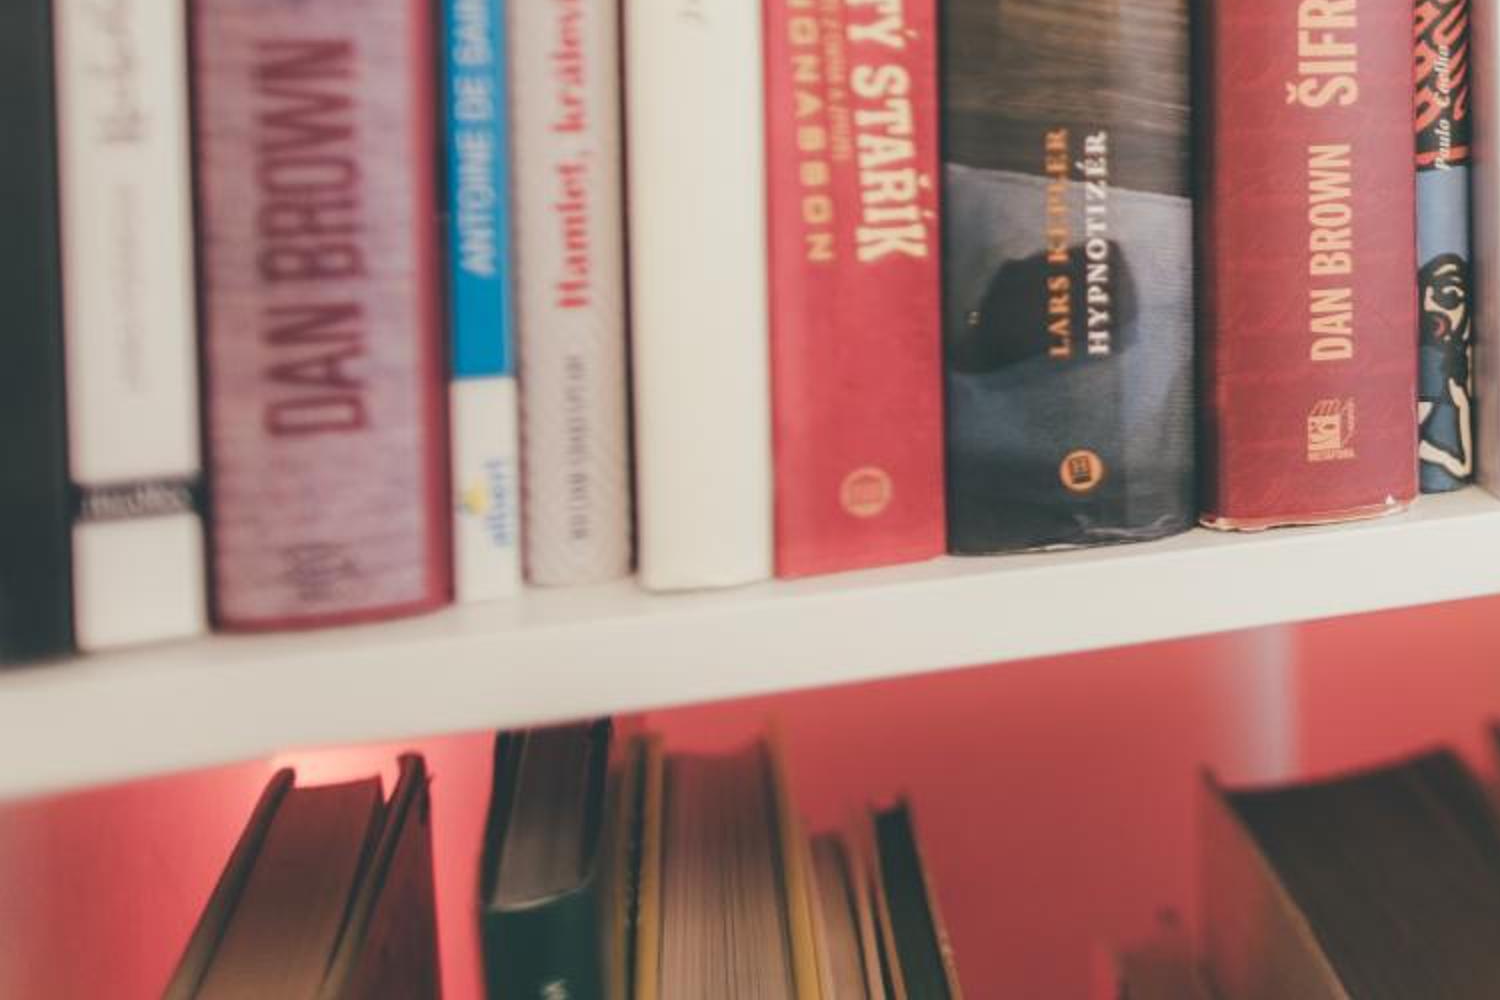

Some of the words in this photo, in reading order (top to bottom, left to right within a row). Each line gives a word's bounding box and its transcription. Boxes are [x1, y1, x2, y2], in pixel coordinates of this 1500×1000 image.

[452, 75, 493, 119] DE
[1431, 44, 1451, 107] Coelho
[255, 36, 366, 285] BROWN
[453, 129, 497, 276] ANTOINE
[850, 64, 934, 263] STAŘÍK
[1044, 128, 1070, 263] KEPLER
[1307, 143, 1353, 275] BROWN
[1434, 118, 1452, 171] Paulo
[553, 149, 592, 309] Hamlet,
[1075, 129, 1110, 354] HYPNOTIZÉR
[264, 301, 370, 438] DAN
[1047, 274, 1072, 357] LARS
[1308, 286, 1354, 361] DAN
